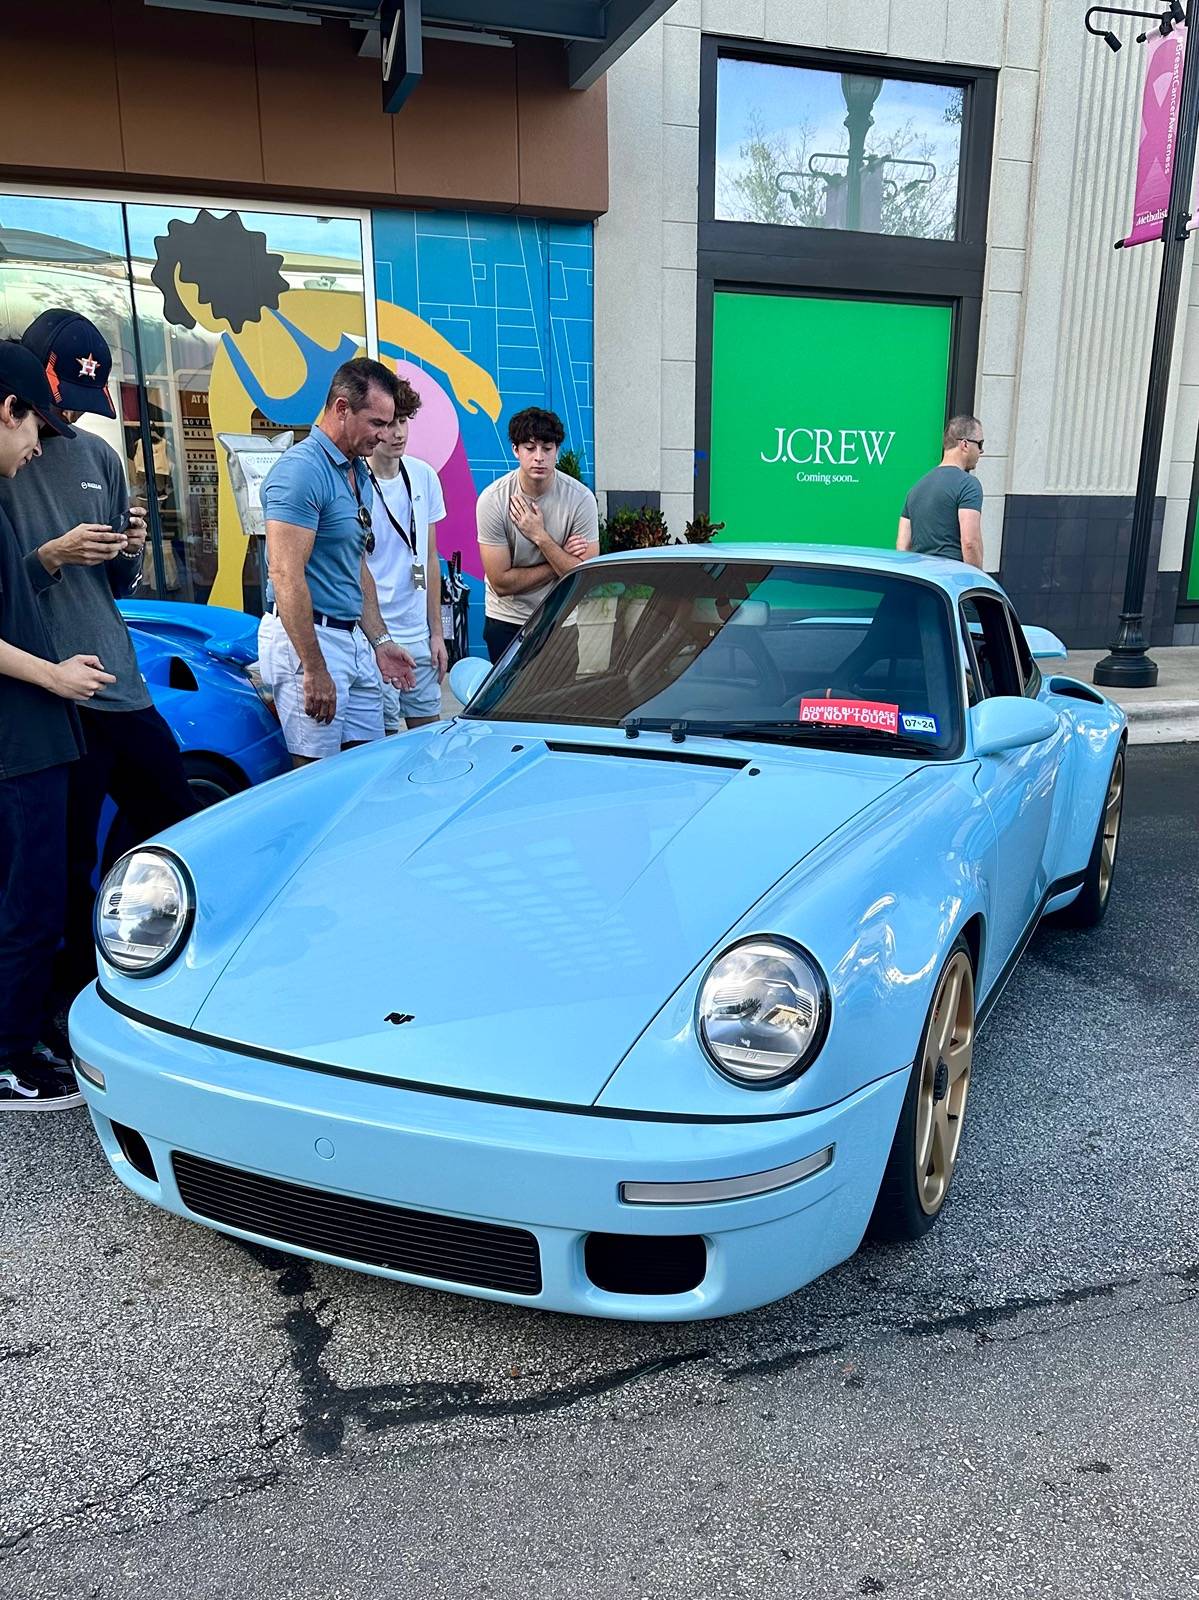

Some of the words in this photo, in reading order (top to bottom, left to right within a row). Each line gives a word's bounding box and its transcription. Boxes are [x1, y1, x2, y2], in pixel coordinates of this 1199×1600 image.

[760, 427, 896, 465] J.CREW
[796, 471, 831, 485] Coming
[832, 472, 859, 483] soon...
[802, 706, 839, 715] ADMIRE
[841, 707, 860, 715] BUT
[862, 708, 897, 719] PLEASE
[802, 712, 819, 721] DO
[823, 712, 849, 722] NOT
[853, 713, 896, 727] TOUCH
